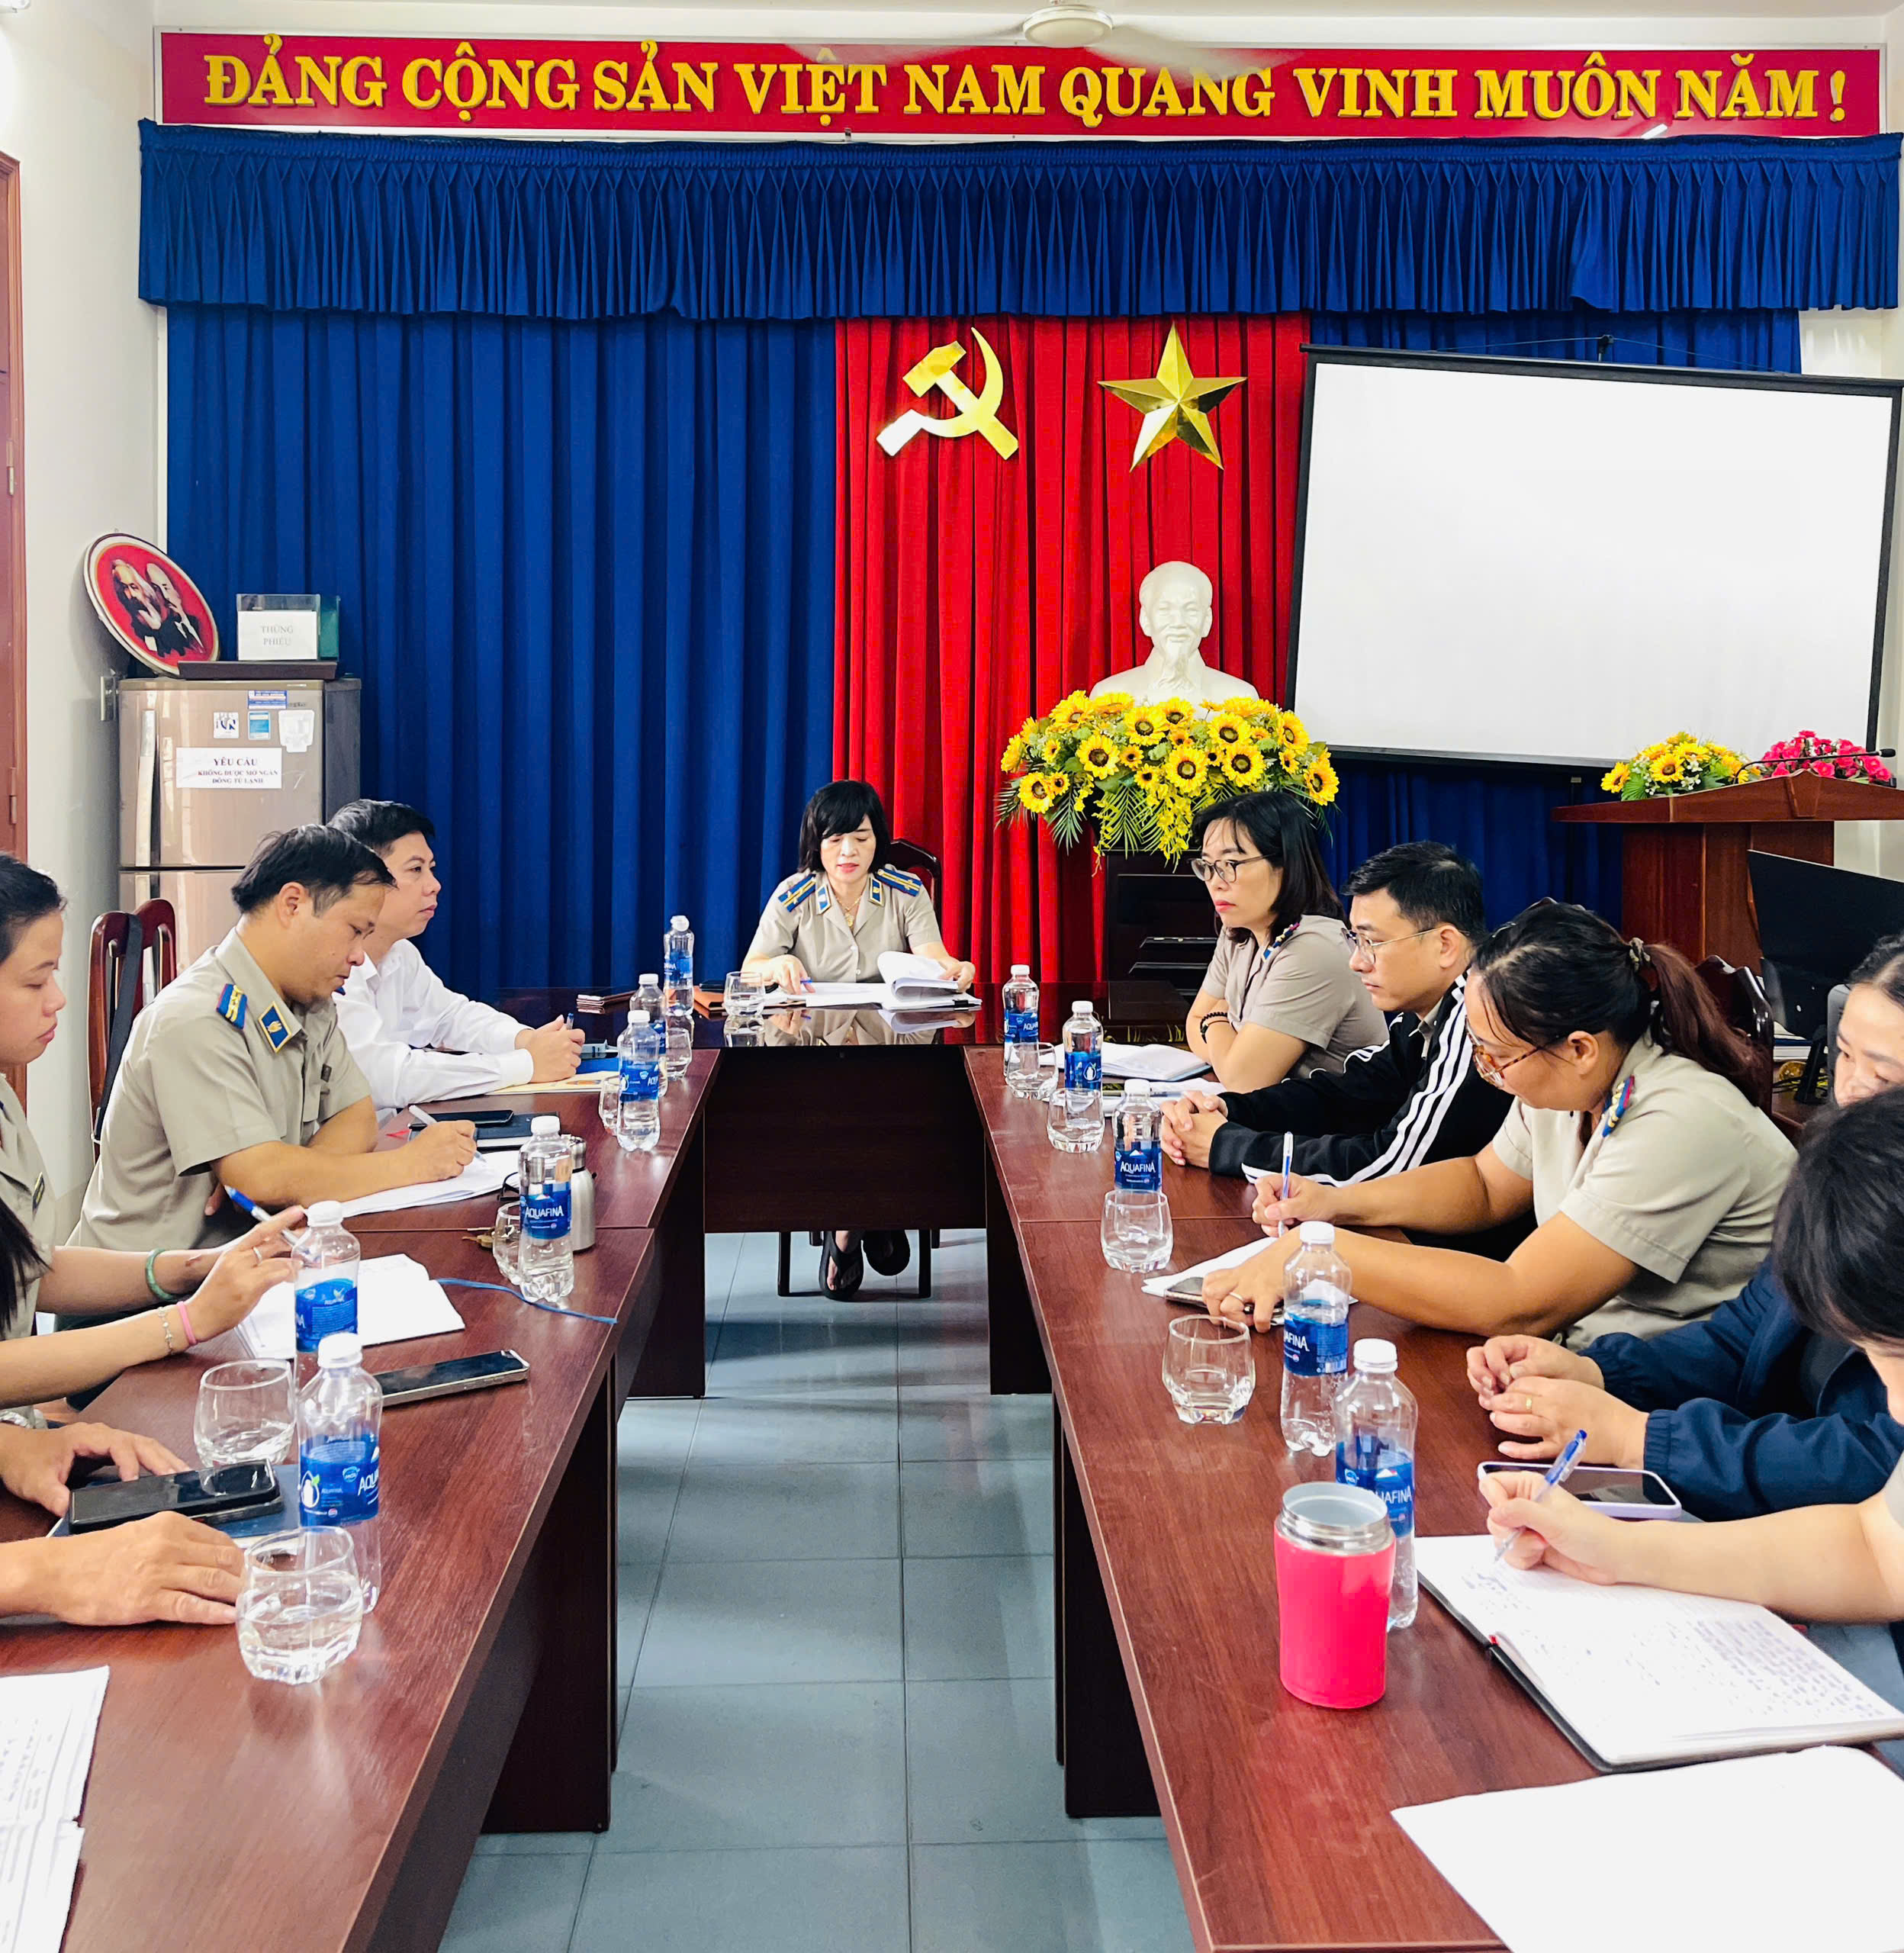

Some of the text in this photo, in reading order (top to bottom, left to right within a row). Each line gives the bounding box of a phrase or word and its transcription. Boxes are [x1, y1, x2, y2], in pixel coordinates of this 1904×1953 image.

[204, 34, 1846, 128] ĐẢNG CỘNG SẢN VIỆT NAM QUANG VINH MUÔN NĂM !
[214, 756, 234, 767] YÊU
[1120, 1160, 1156, 1174] AQUAFINA
[525, 1205, 564, 1220] AQUAFINA
